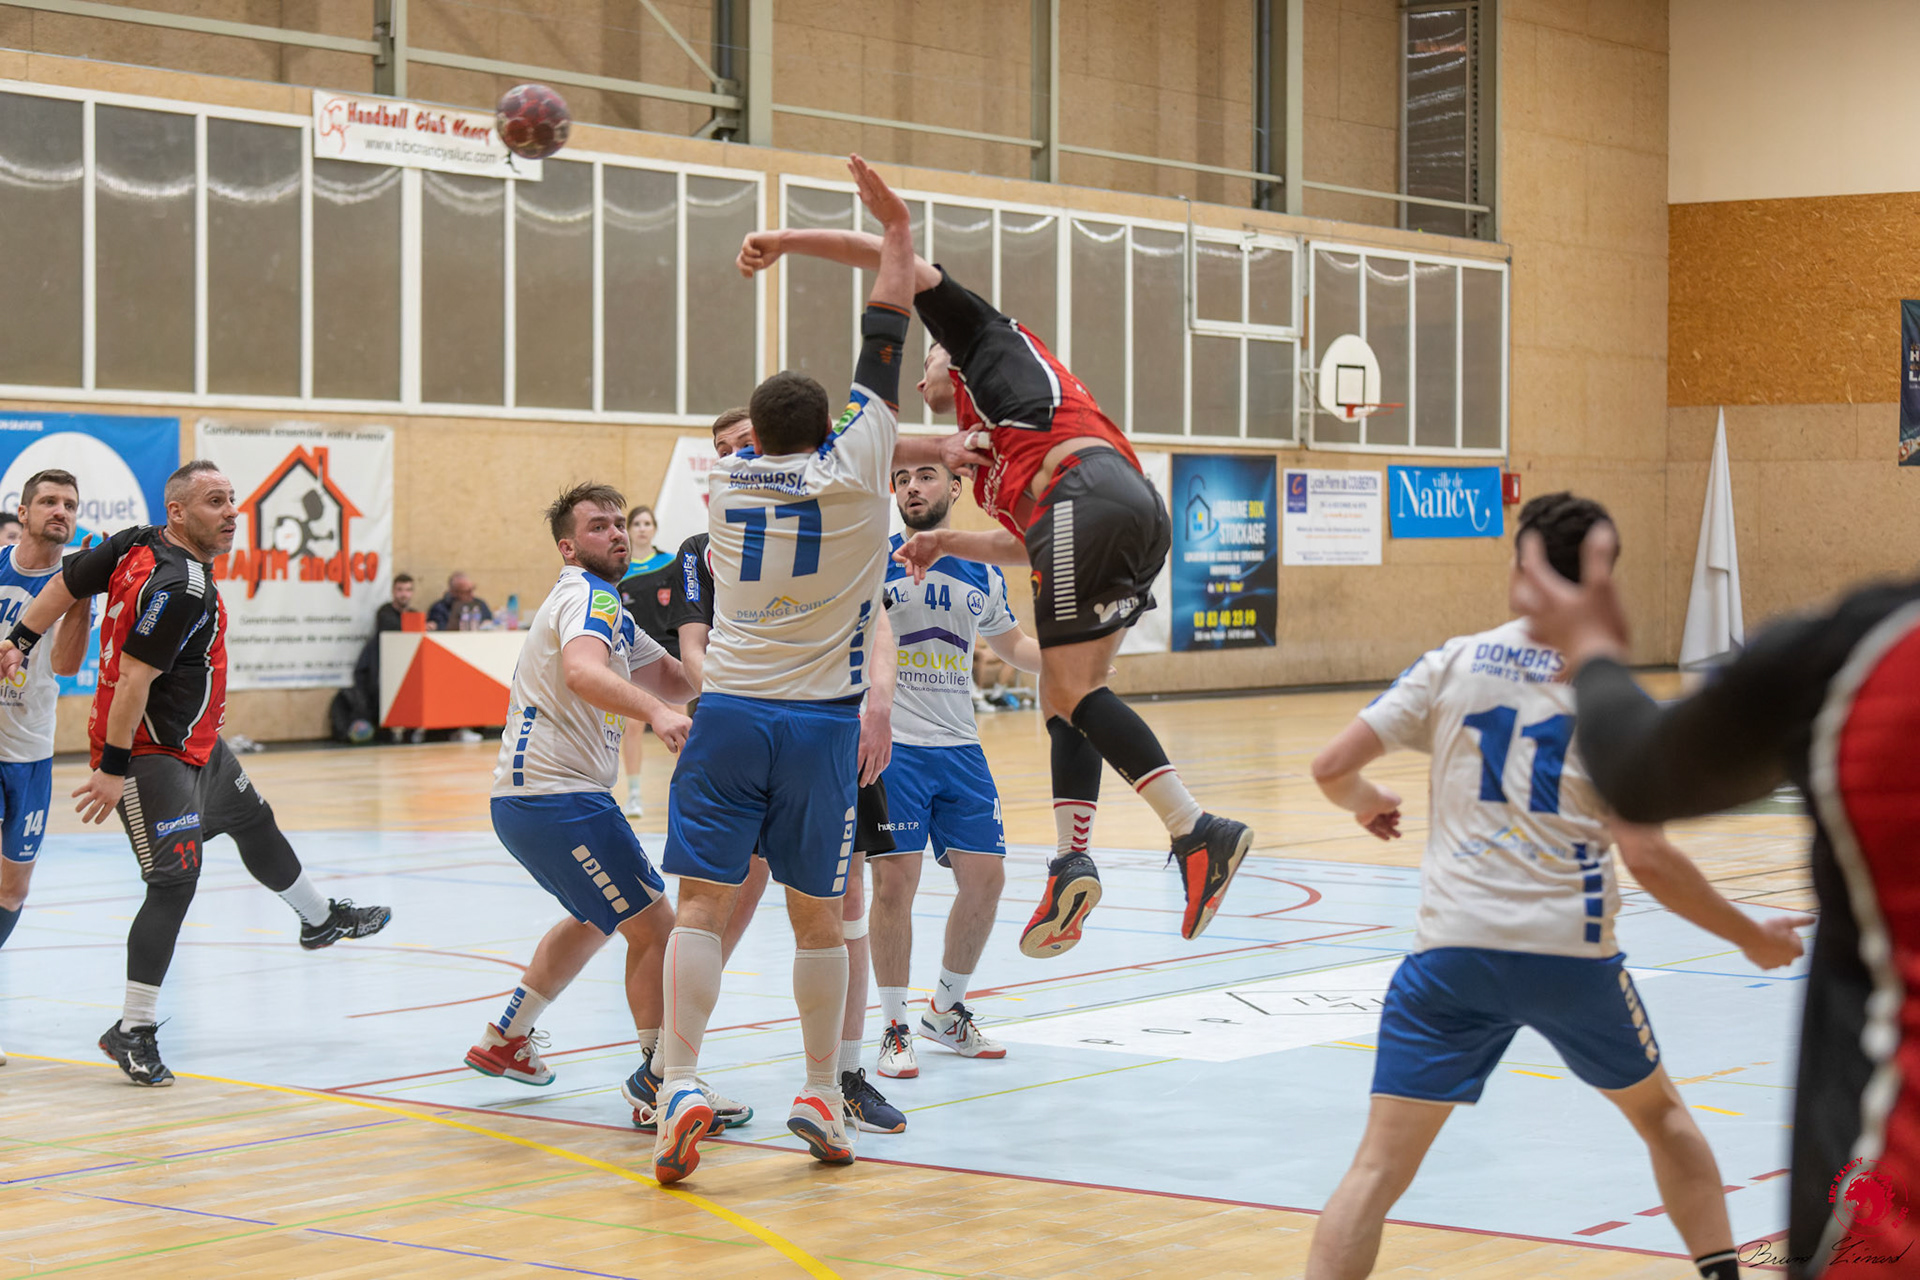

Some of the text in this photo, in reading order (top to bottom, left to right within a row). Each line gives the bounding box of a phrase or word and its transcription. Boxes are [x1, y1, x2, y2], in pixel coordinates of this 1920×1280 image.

[347, 102, 408, 129] Handball
[415, 112, 446, 134] Club
[1432, 472, 1463, 488] ville de
[1397, 470, 1490, 532] Nancy
[725, 498, 822, 581] 77
[1219, 523, 1266, 544] STOCKAGE
[300, 552, 342, 583] and
[683, 569, 696, 601] Grand
[925, 583, 952, 612] 44
[0, 597, 23, 627] 14
[140, 592, 170, 636] Grand Est
[736, 607, 791, 619] DEMANGE
[1475, 643, 1565, 673] DOMBAS
[900, 670, 969, 686] mmobilier
[1463, 705, 1577, 814] 11
[23, 809, 44, 837] 14
[156, 814, 200, 832] Grand Est
[173, 840, 198, 870] 11
